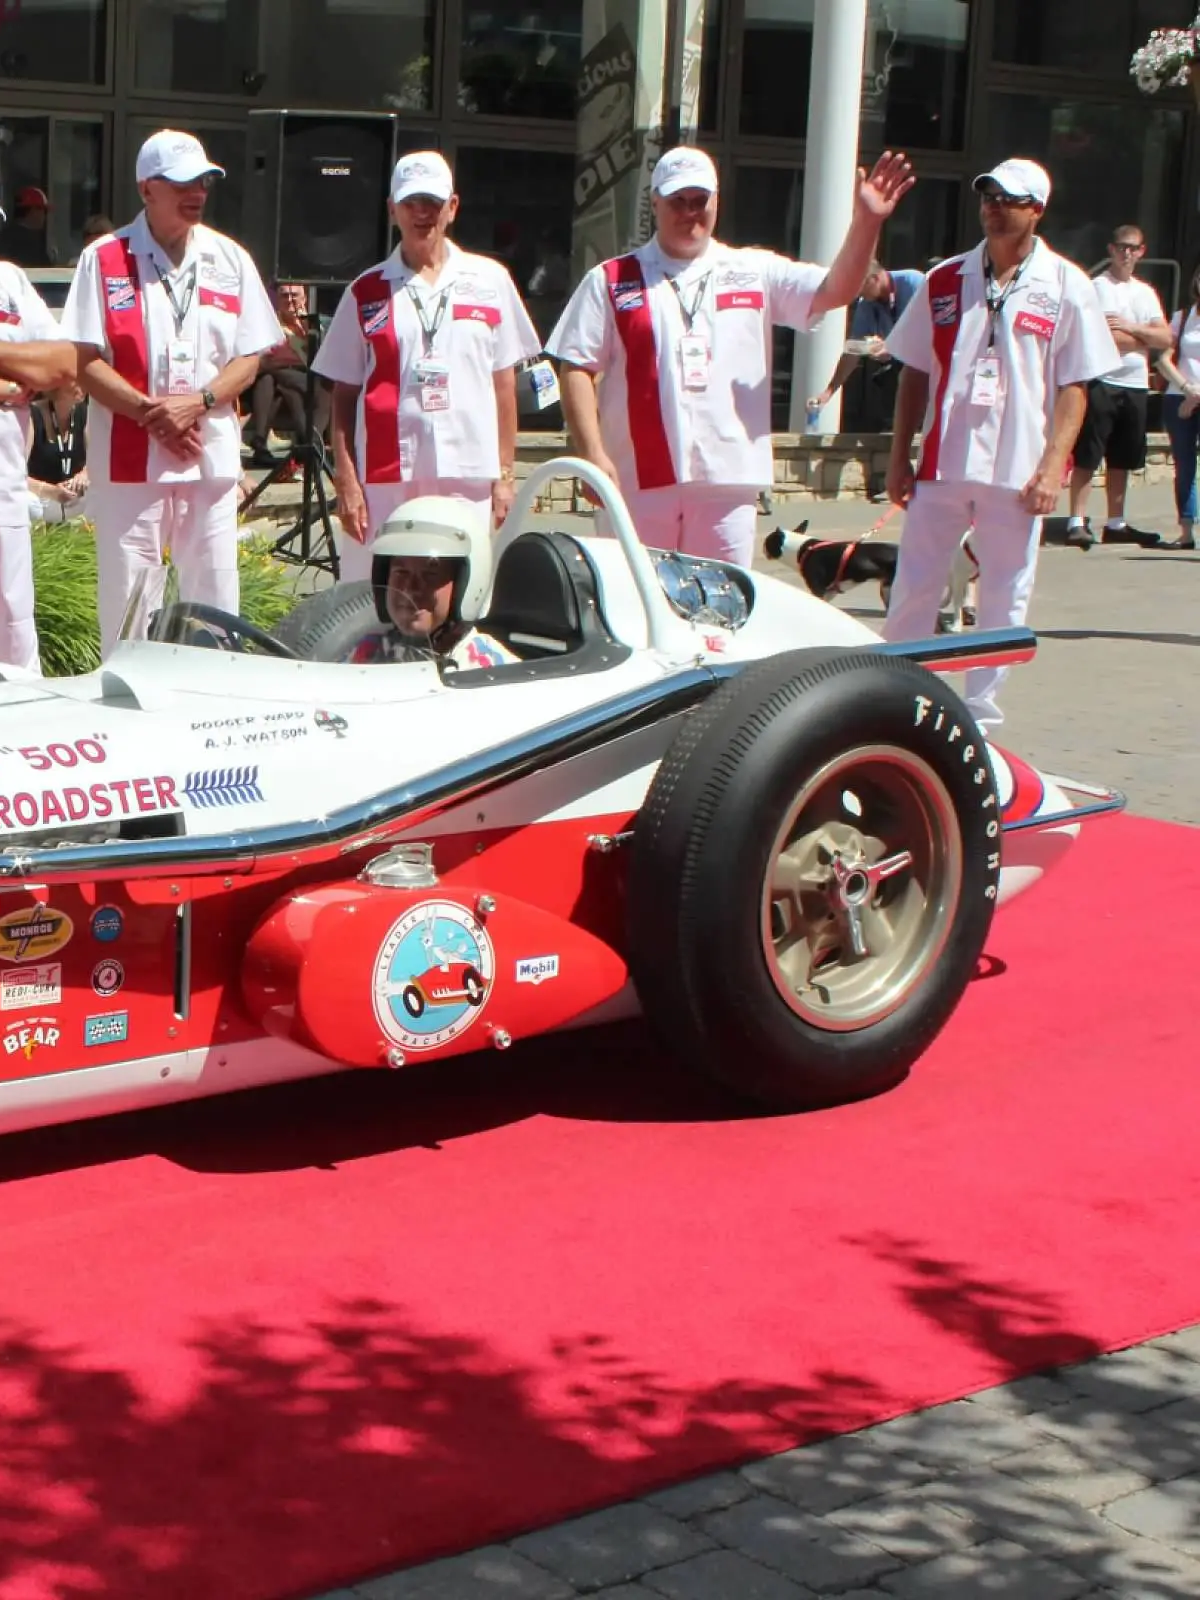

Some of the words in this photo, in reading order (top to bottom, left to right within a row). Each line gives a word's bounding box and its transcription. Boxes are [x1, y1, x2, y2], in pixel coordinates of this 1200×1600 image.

[573, 132, 637, 206] PIE
[242, 727, 308, 745] WATSON
[914, 695, 1000, 899] Firestone
[9, 922, 54, 938] MONROE
[380, 916, 417, 970] LEADER
[518, 959, 556, 976] Mobil
[2, 1027, 61, 1055] BEAR
